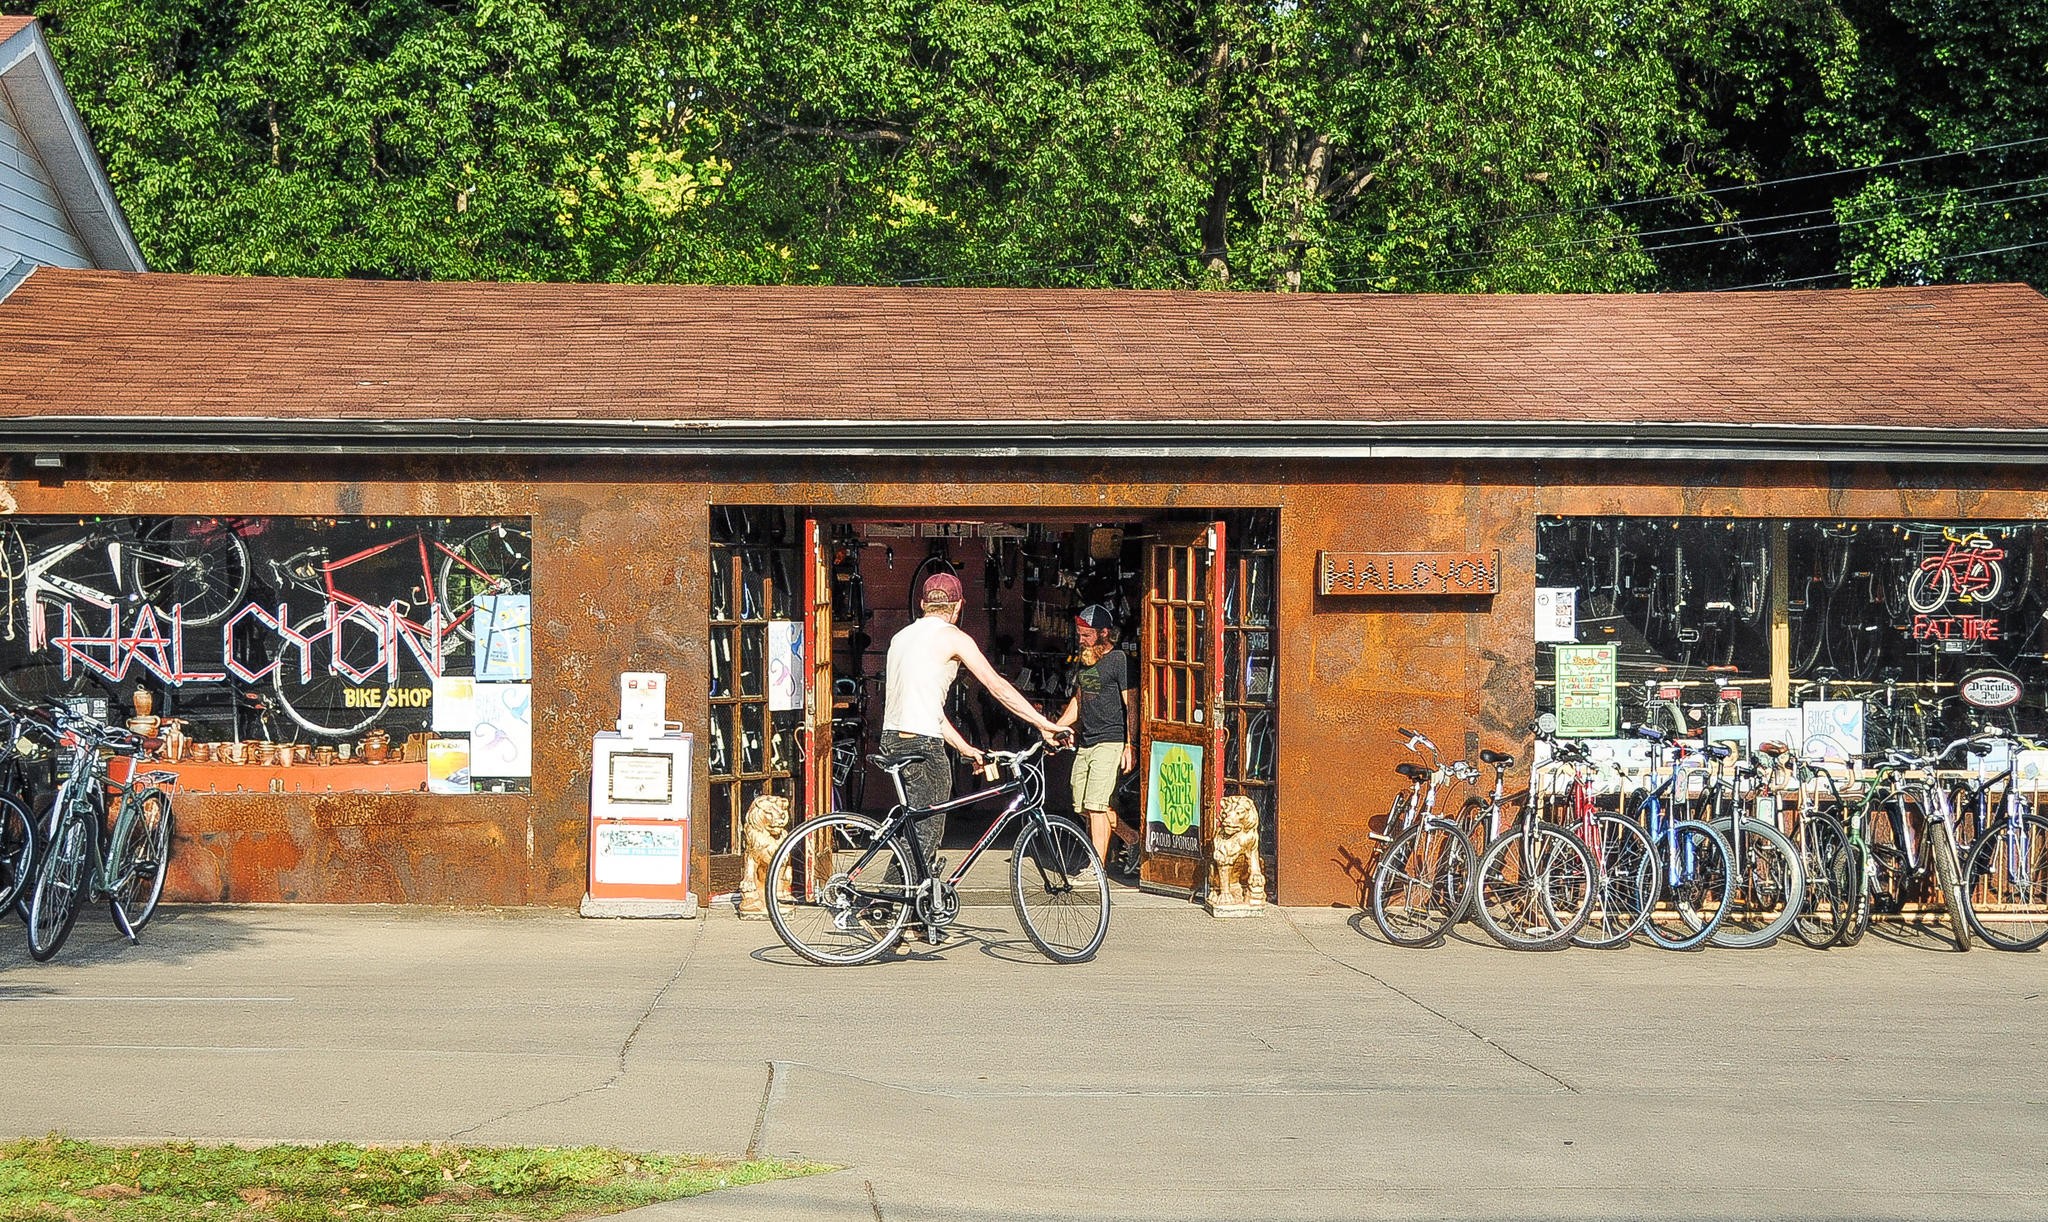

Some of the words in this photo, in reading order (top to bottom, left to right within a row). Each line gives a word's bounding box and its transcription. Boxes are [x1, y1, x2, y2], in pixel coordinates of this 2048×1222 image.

[1327, 559, 1496, 593] HALCYON
[50, 575, 115, 604] TREK
[1912, 614, 1955, 640] FAT
[1955, 614, 1999, 641] TIRE
[50, 602, 442, 687] HALCYON
[343, 688, 382, 708] BIKE
[386, 687, 432, 708] SHOP
[1981, 691, 2000, 700] Pub
[1807, 710, 1831, 724] BIKE
[1150, 831, 1172, 848] PROUD
[1172, 834, 1199, 852] SPONSOR
